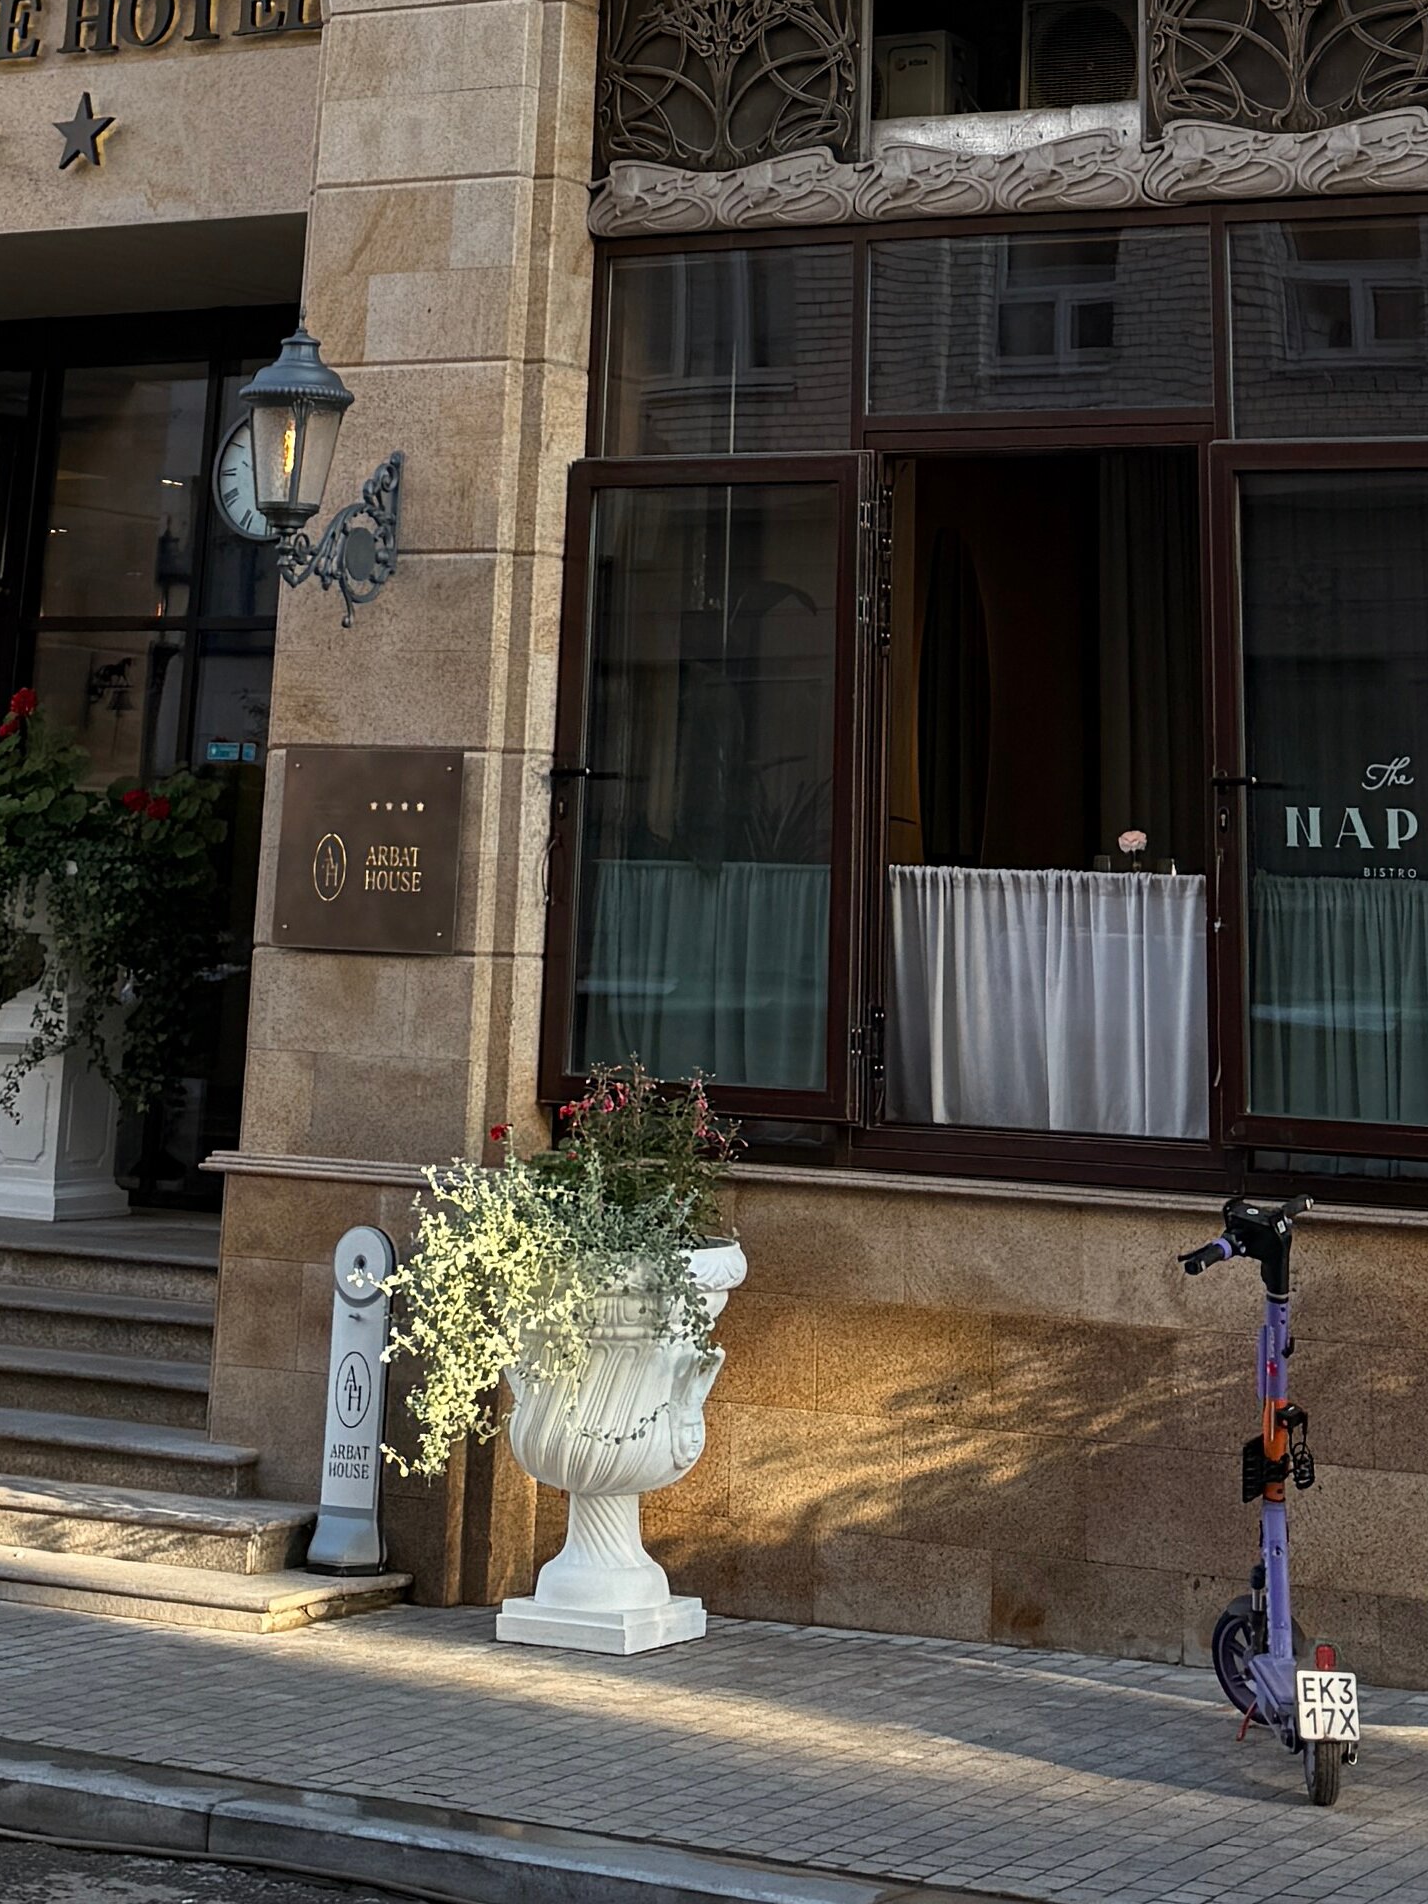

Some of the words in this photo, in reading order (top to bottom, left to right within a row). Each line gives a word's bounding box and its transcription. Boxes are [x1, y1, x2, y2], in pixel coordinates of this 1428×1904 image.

[1361, 756, 1414, 790] The
[365, 845, 420, 868] ARBAT
[364, 869, 422, 892] HOUSE
[1363, 867, 1418, 879] BISTRO
[330, 1444, 370, 1461] ARBAT
[328, 1462, 370, 1479] HOUSE
[1305, 1707, 1357, 1737] 17X
